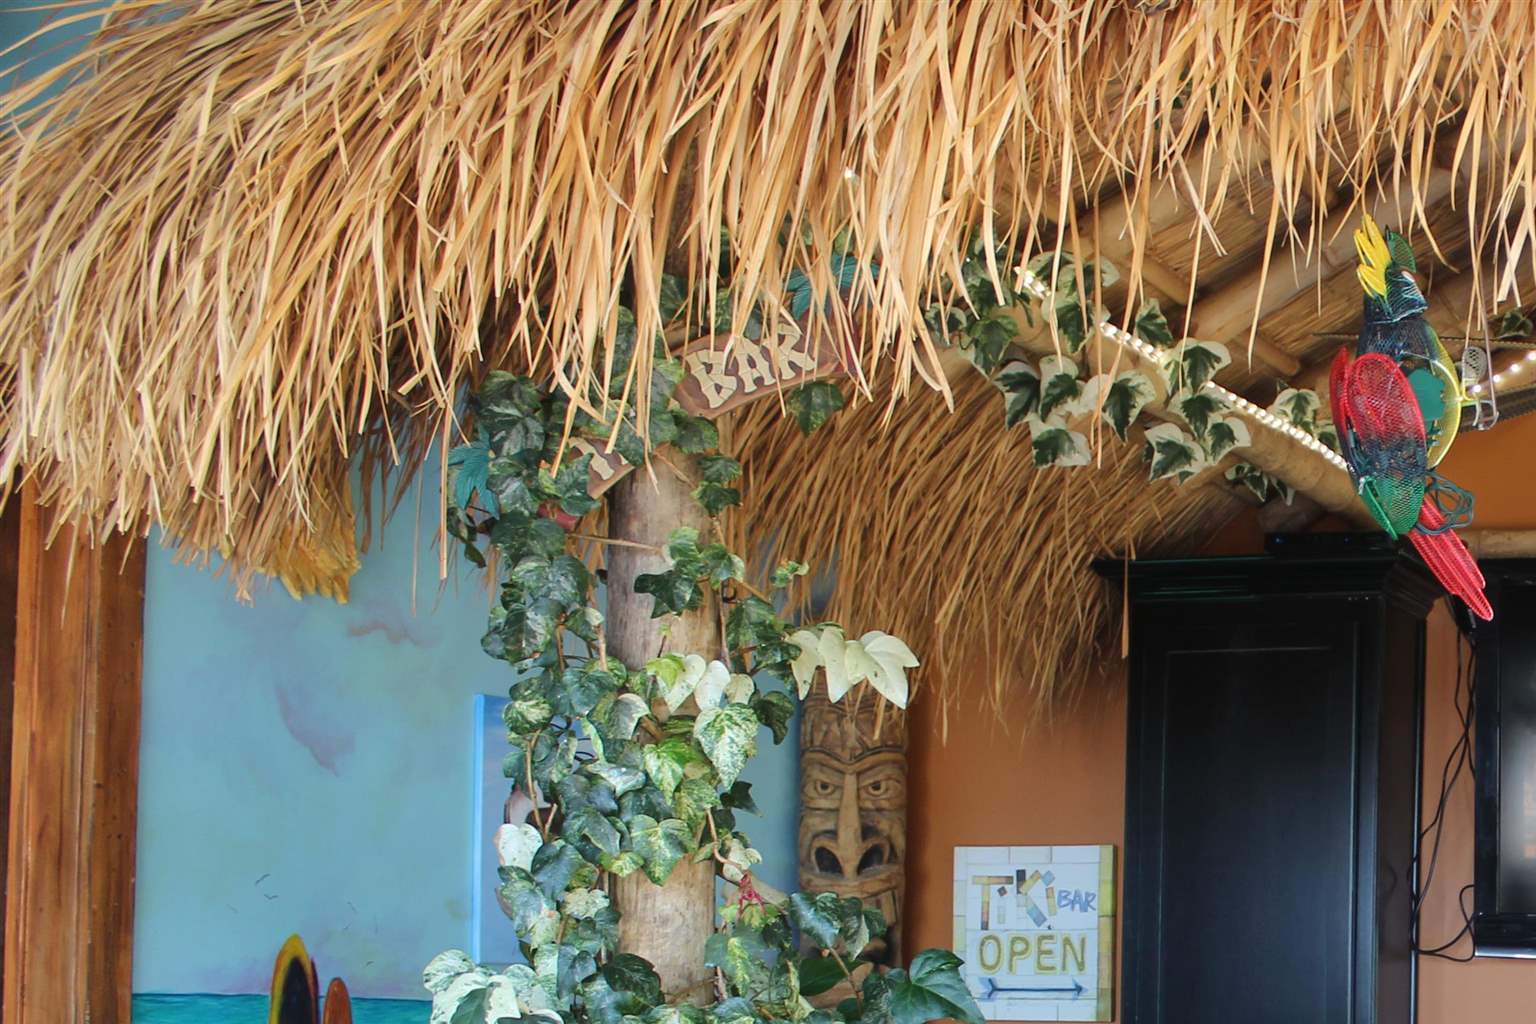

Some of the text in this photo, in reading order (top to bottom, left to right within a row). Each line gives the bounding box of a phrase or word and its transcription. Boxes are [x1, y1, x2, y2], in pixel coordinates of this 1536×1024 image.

[685, 323, 817, 408] BAR
[1056, 889, 1096, 912] BAR
[979, 933, 1088, 975] OPEN
